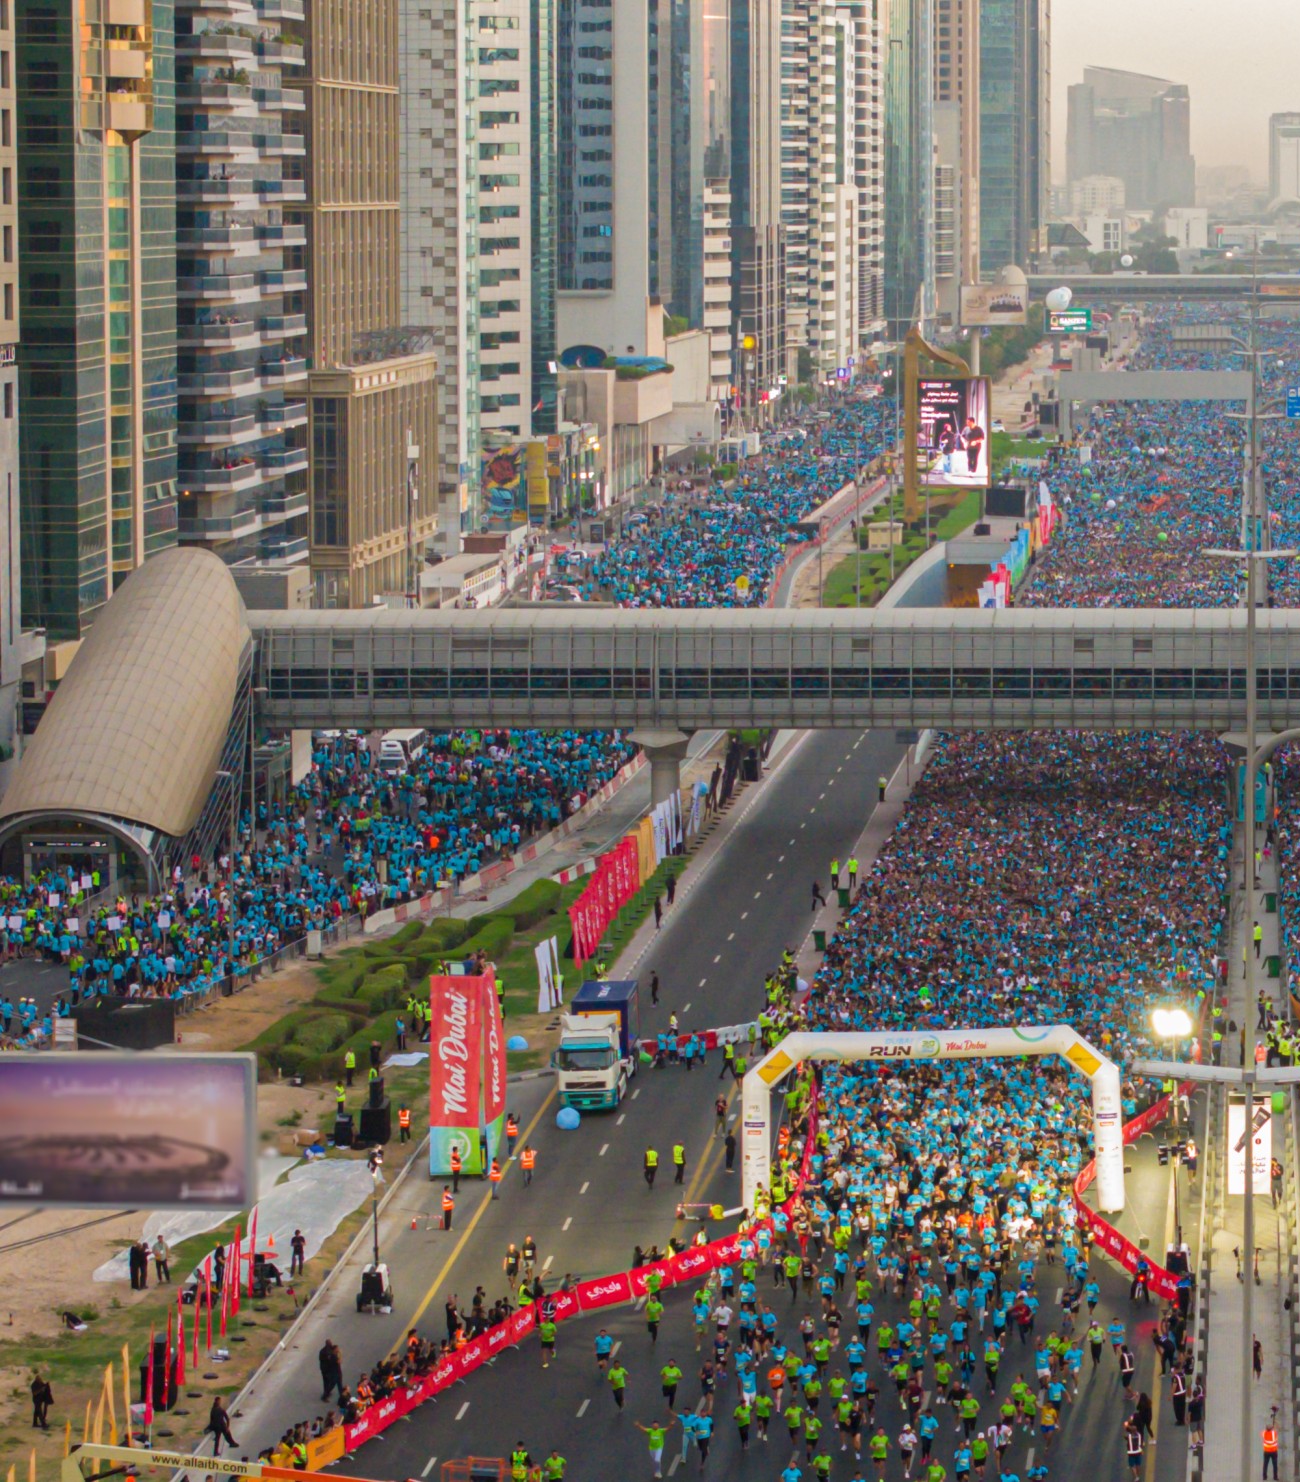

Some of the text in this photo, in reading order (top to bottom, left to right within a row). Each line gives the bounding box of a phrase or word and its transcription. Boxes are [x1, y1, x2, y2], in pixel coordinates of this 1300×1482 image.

[438, 991, 469, 1062] Dubai
[870, 1046, 911, 1056] RUN
[441, 1063, 468, 1116] Mai
[151, 1453, 248, 1474] www.allaith.com
